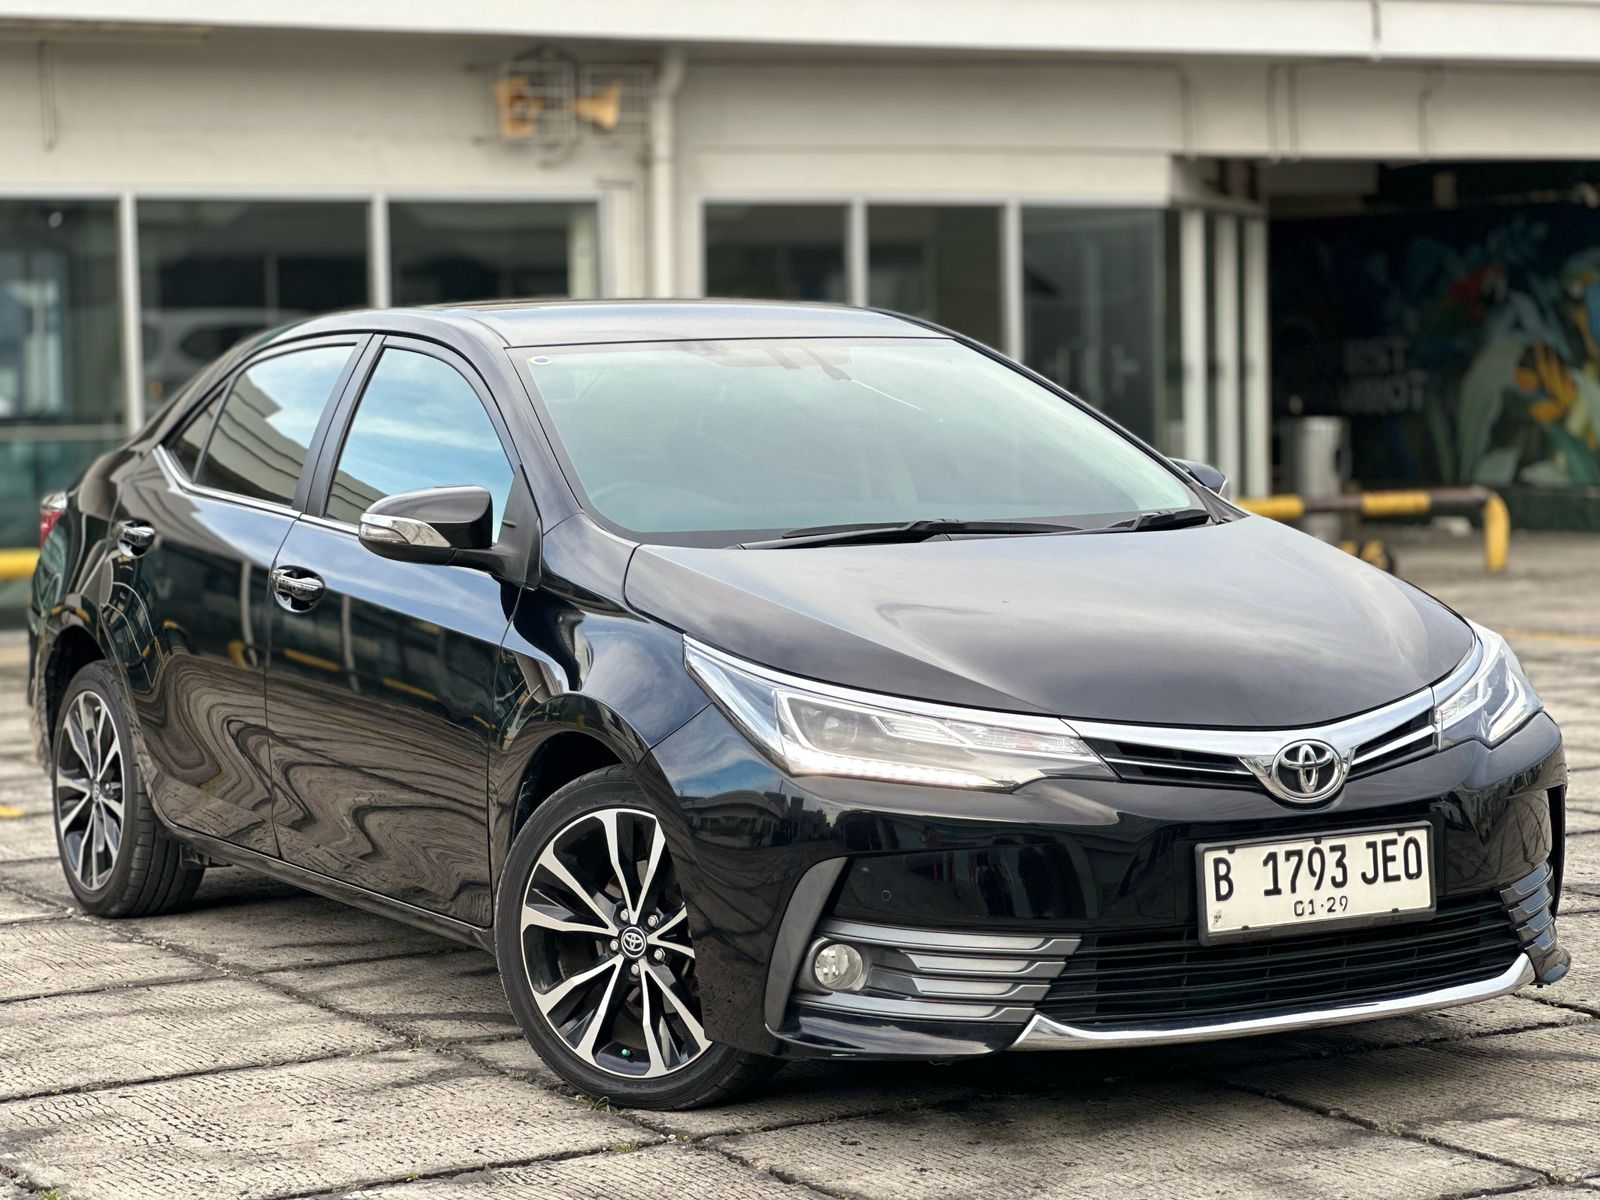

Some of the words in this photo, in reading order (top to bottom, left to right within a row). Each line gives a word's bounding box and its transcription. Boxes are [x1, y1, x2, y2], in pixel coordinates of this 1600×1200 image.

[1213, 857, 1234, 901] B
[1262, 844, 1348, 896] 1793
[1360, 837, 1423, 885] JEO
